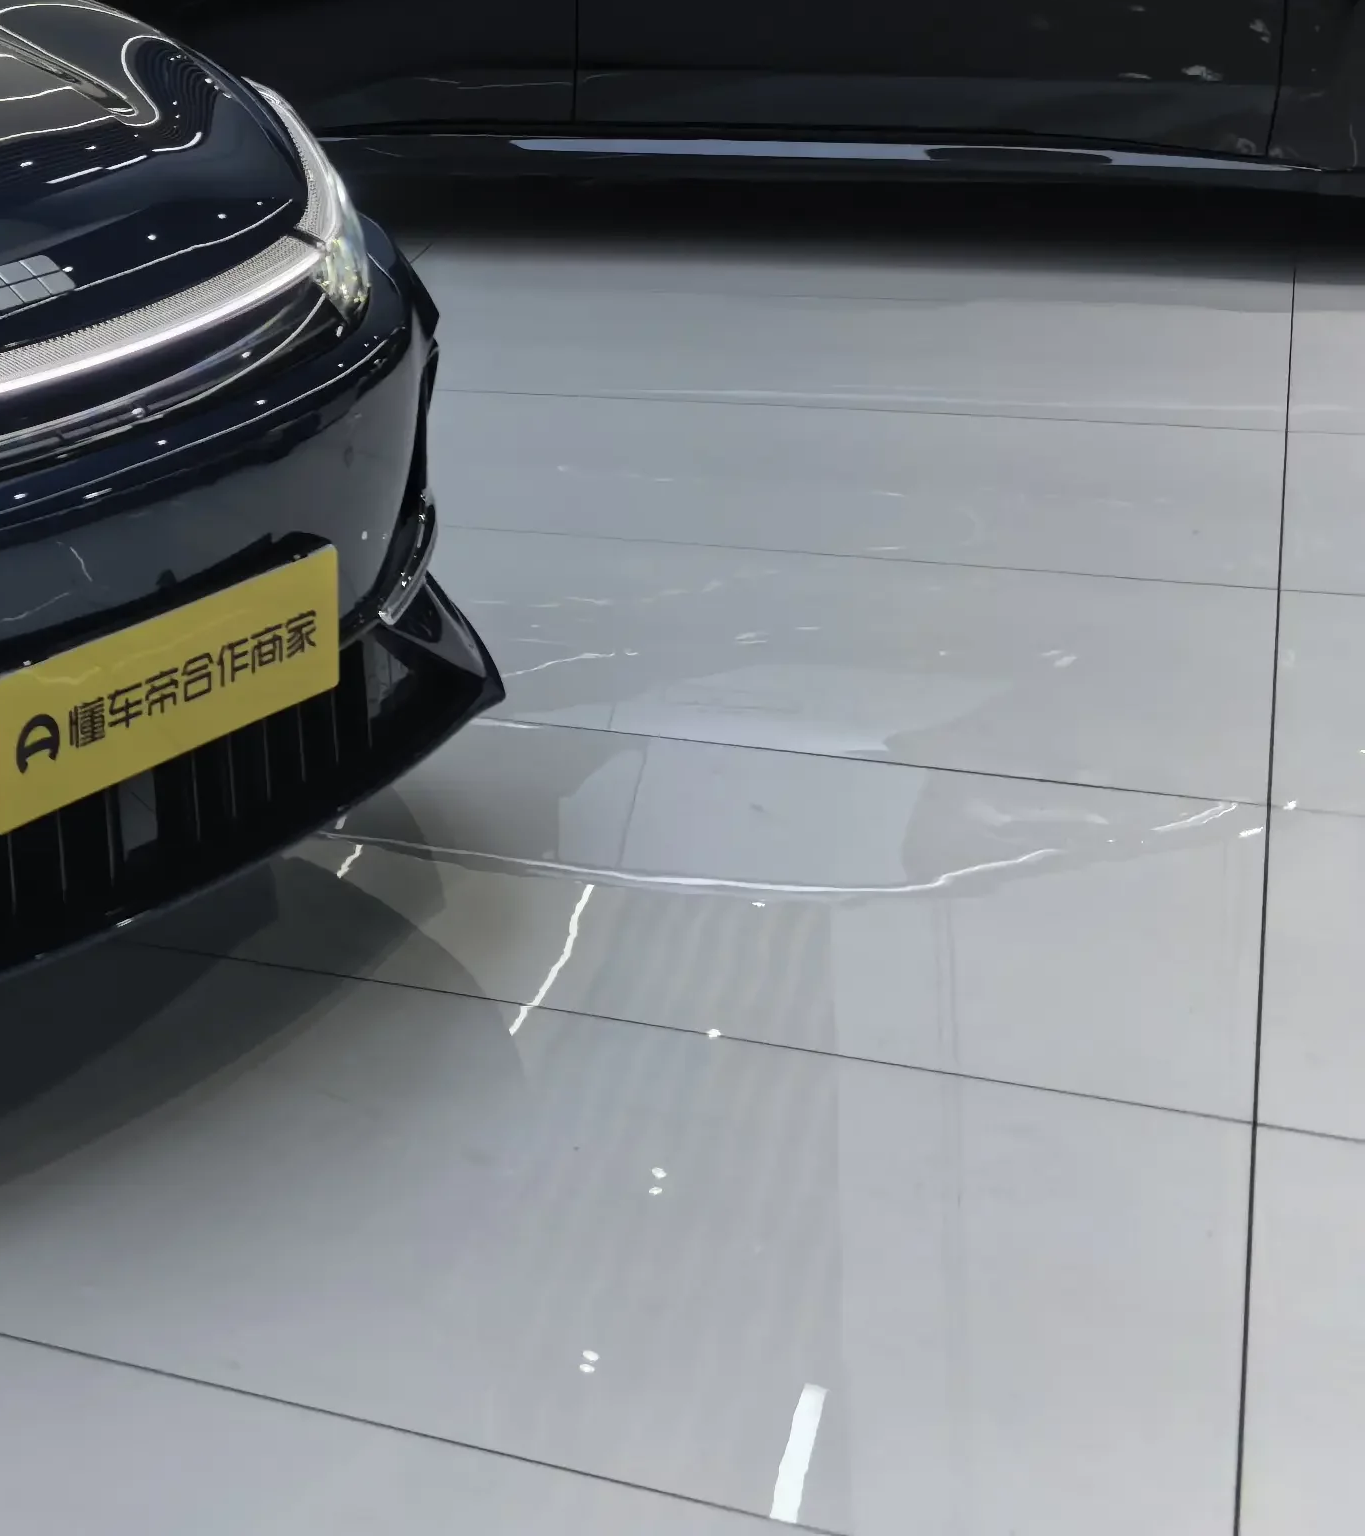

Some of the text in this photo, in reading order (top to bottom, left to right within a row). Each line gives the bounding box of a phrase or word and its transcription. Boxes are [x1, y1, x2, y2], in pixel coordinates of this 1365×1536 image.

[69, 610, 318, 749] 懂车帝合作商家
